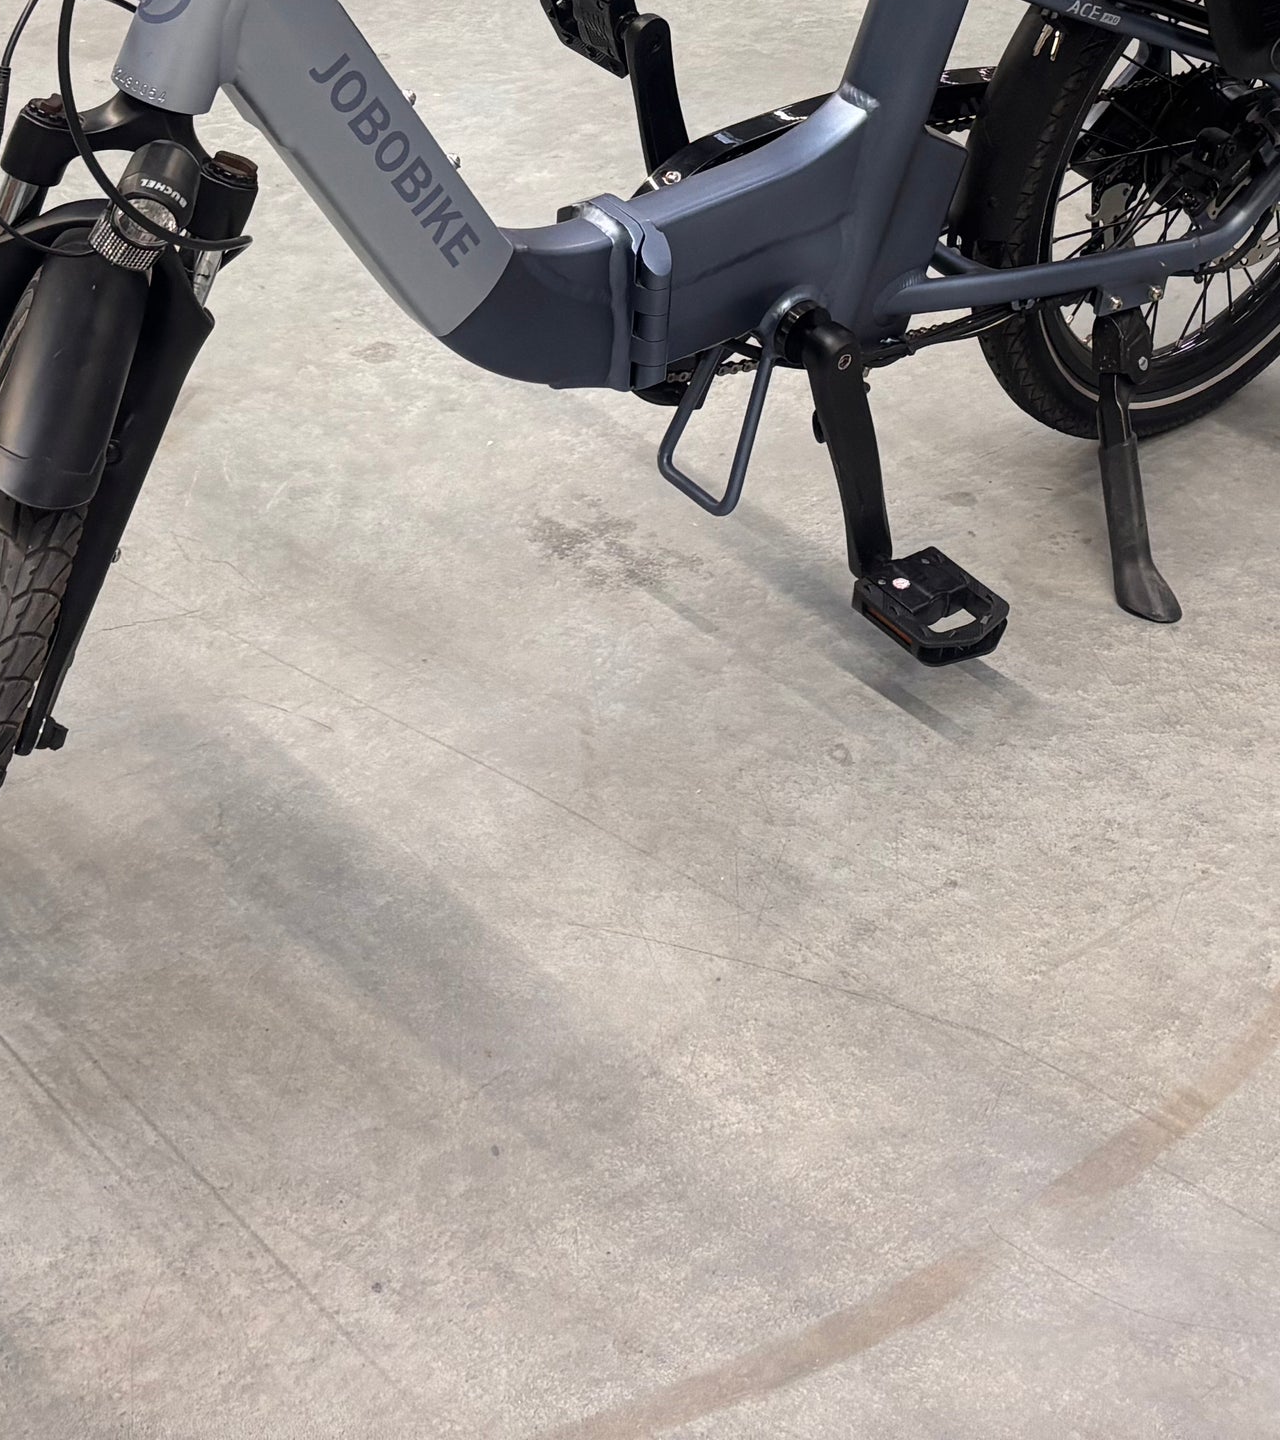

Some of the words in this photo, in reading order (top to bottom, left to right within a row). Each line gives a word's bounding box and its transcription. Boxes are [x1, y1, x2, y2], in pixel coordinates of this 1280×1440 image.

[1066, 0, 1103, 21] ACE
[1100, 12, 1121, 26] PRO
[308, 52, 481, 268] JOBOBIKE
[140, 178, 188, 209] BUCHEL
